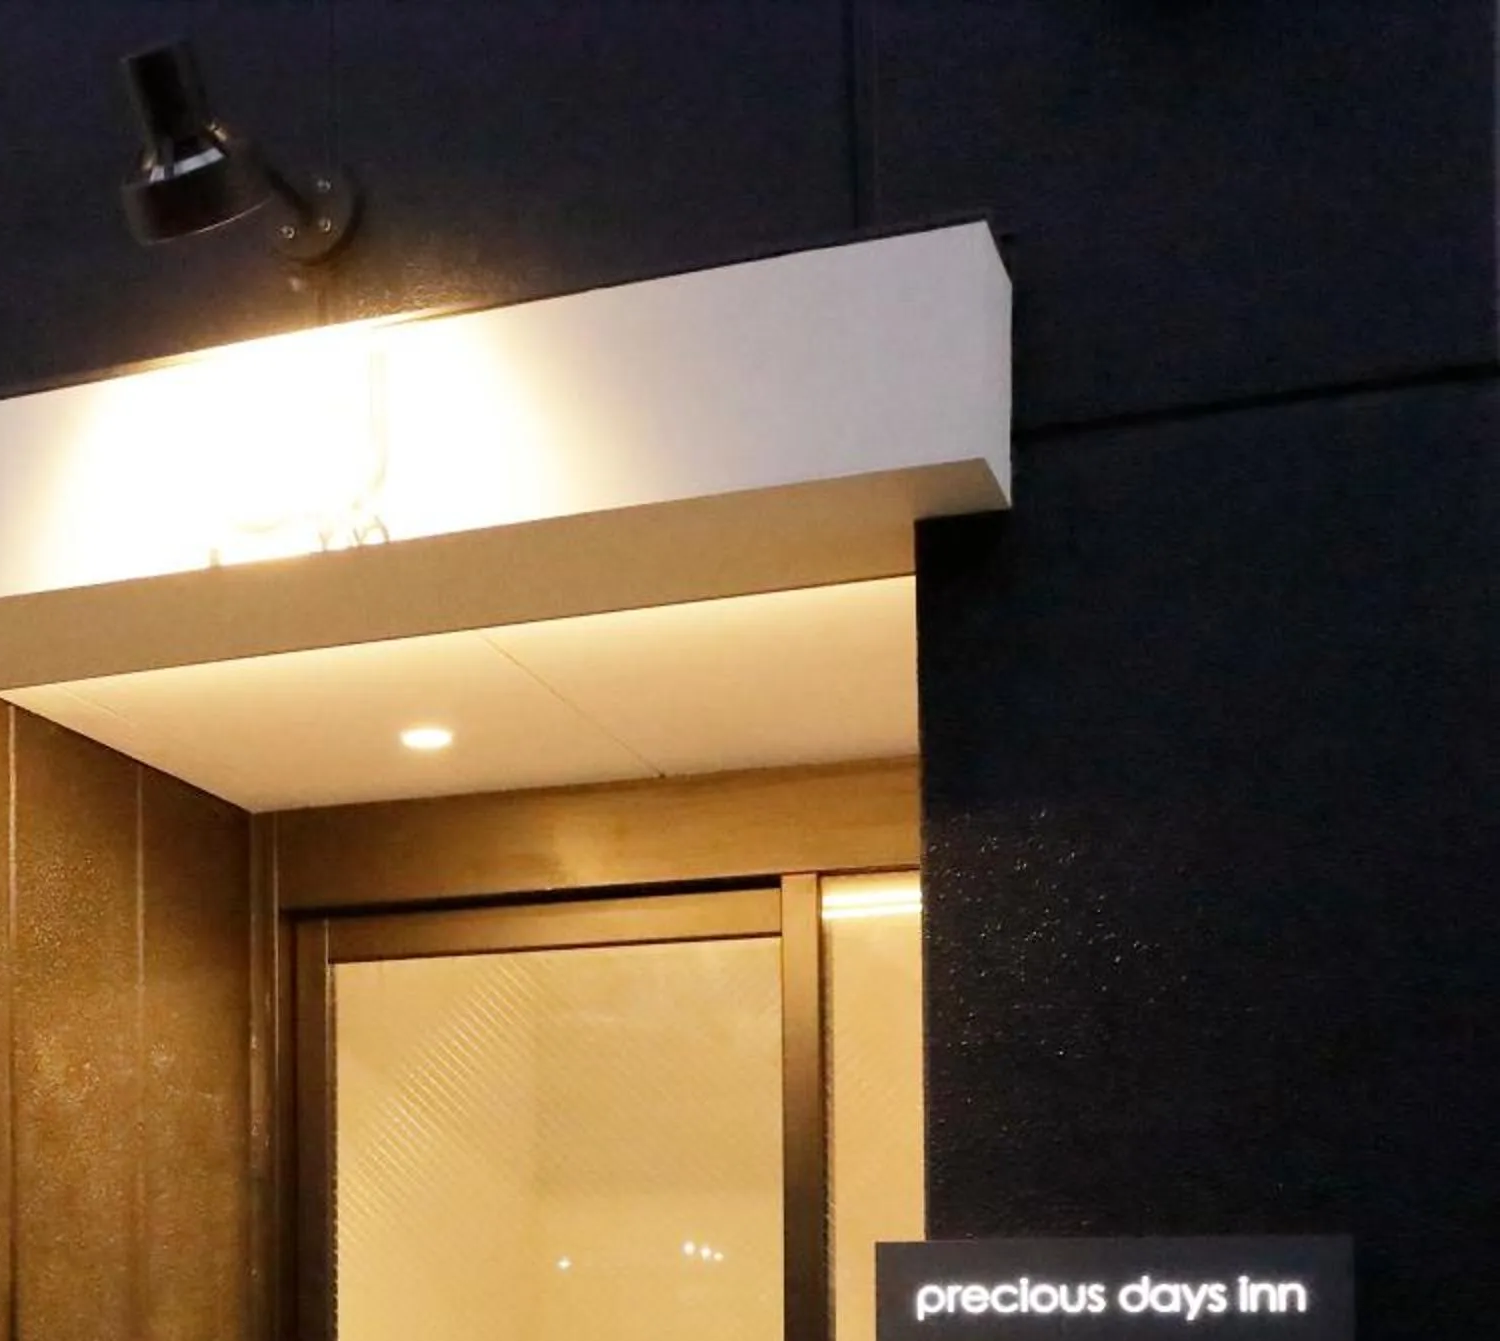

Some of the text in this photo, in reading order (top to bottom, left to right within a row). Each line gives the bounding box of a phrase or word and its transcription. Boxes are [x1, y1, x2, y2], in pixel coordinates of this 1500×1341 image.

[916, 1275, 1307, 1321] precious days inn
